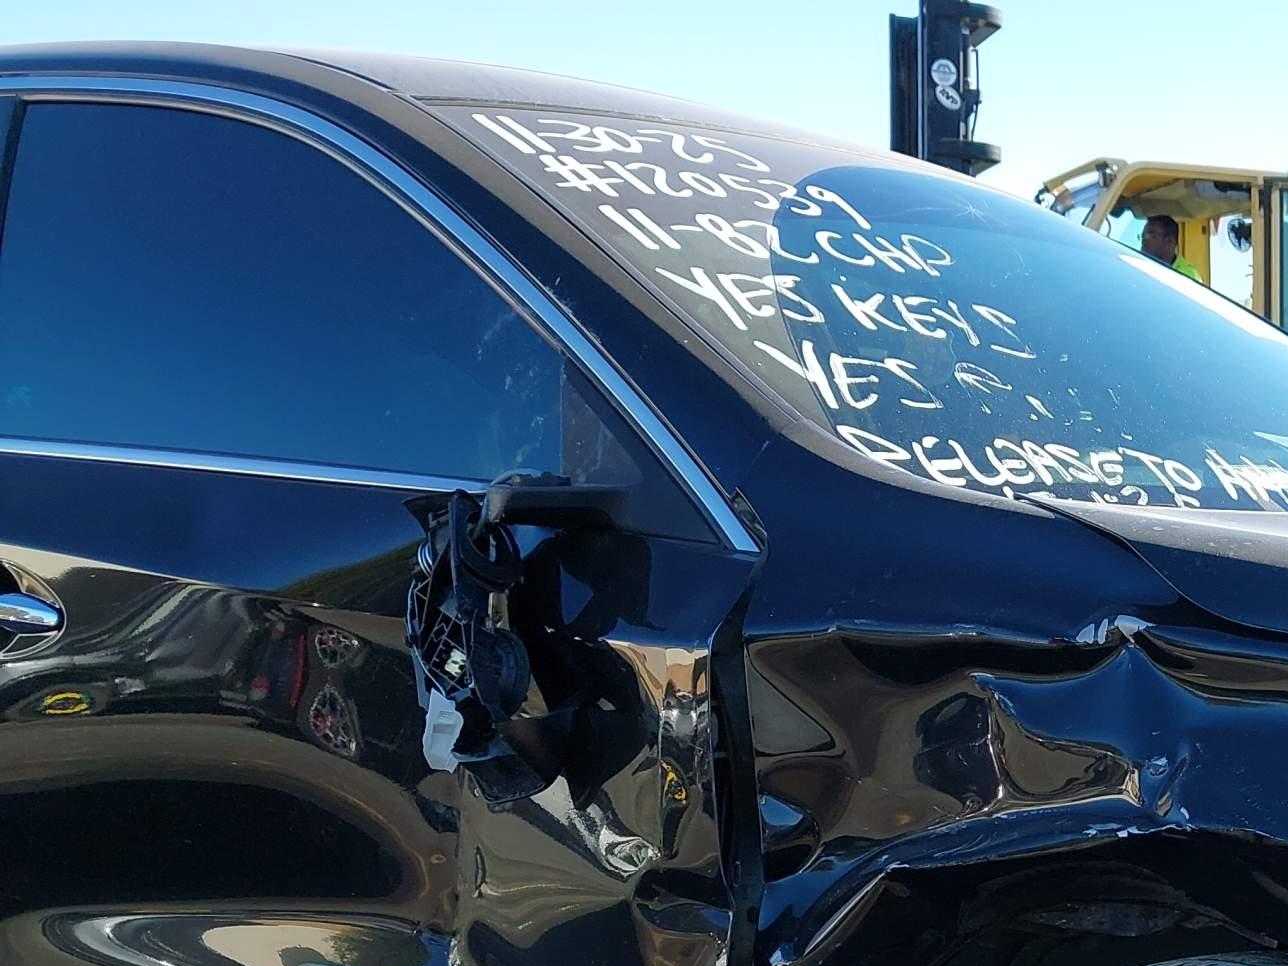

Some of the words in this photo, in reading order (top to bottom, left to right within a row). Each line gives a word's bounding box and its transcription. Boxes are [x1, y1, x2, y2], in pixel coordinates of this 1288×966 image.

[539, 154, 871, 230] #120539
[656, 267, 825, 331] YES
[831, 283, 1038, 359] KEYS
[754, 340, 944, 410] YES
[1118, 446, 1202, 492] TO
